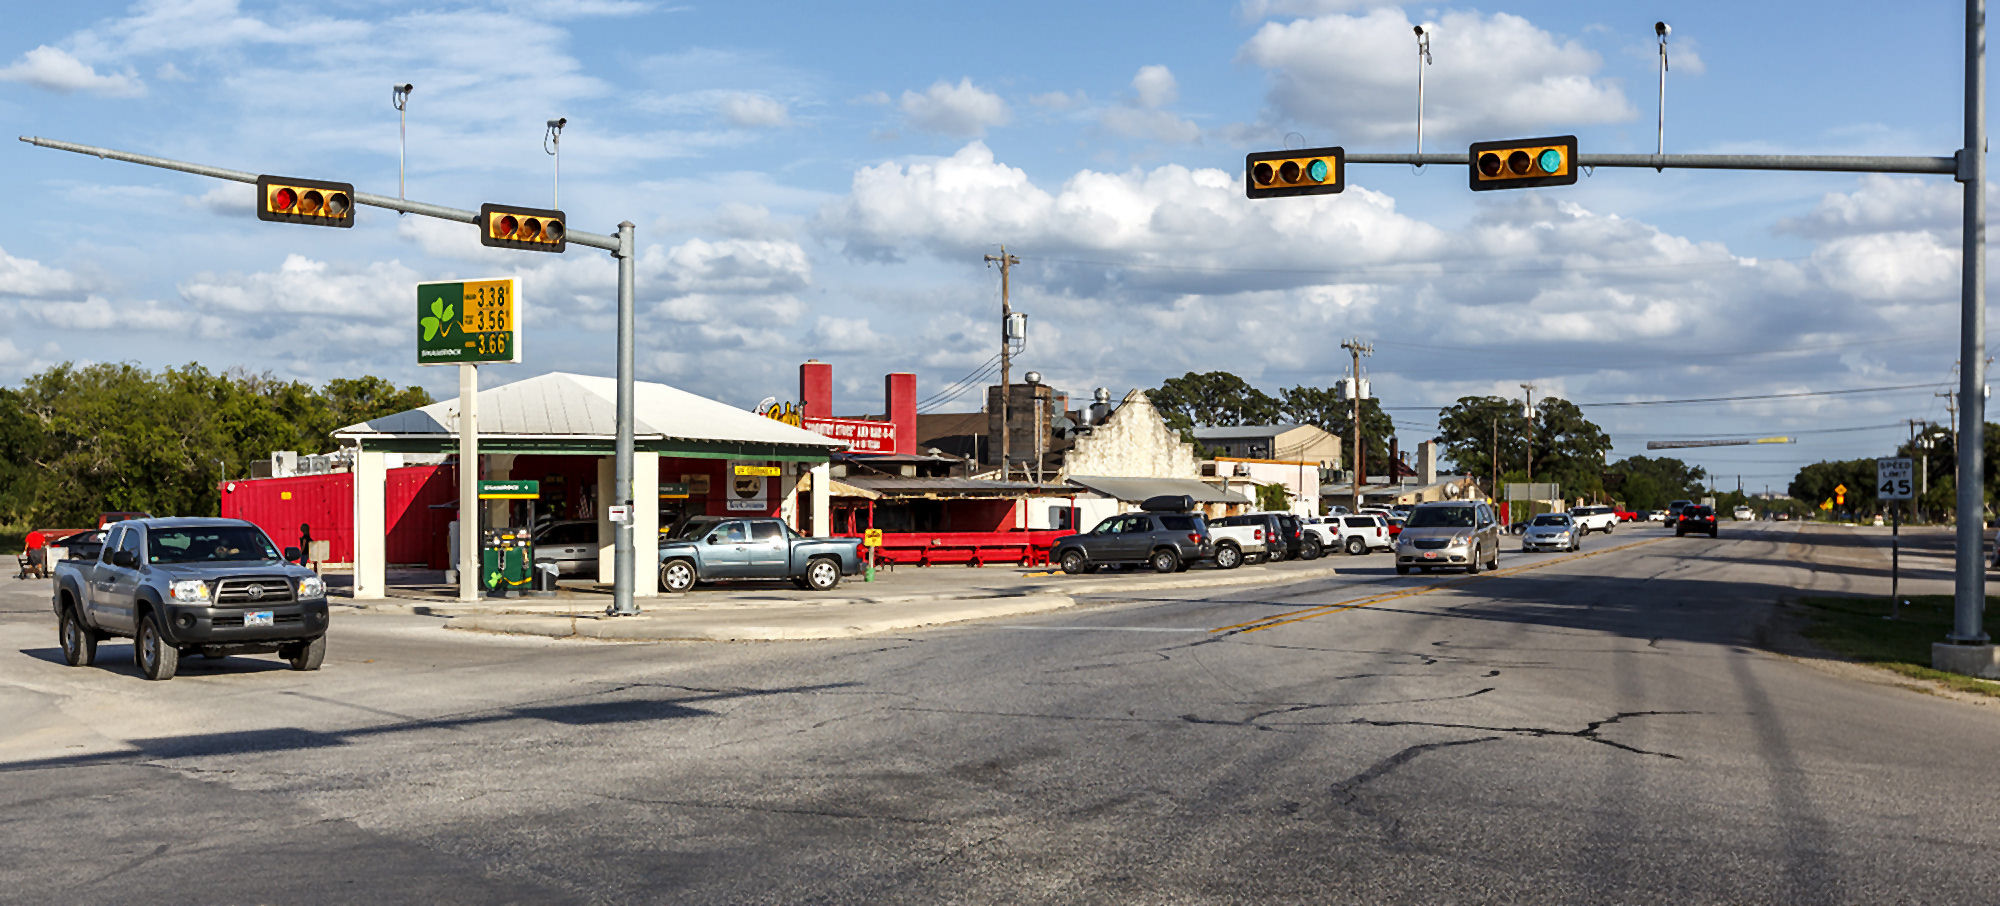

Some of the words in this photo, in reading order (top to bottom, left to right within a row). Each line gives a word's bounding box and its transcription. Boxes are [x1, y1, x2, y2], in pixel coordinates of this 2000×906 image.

[477, 286, 505, 307] 3.38
[477, 310, 505, 331] 3.56
[478, 334, 506, 354] 3.66
[1880, 480, 1910, 495] 45
